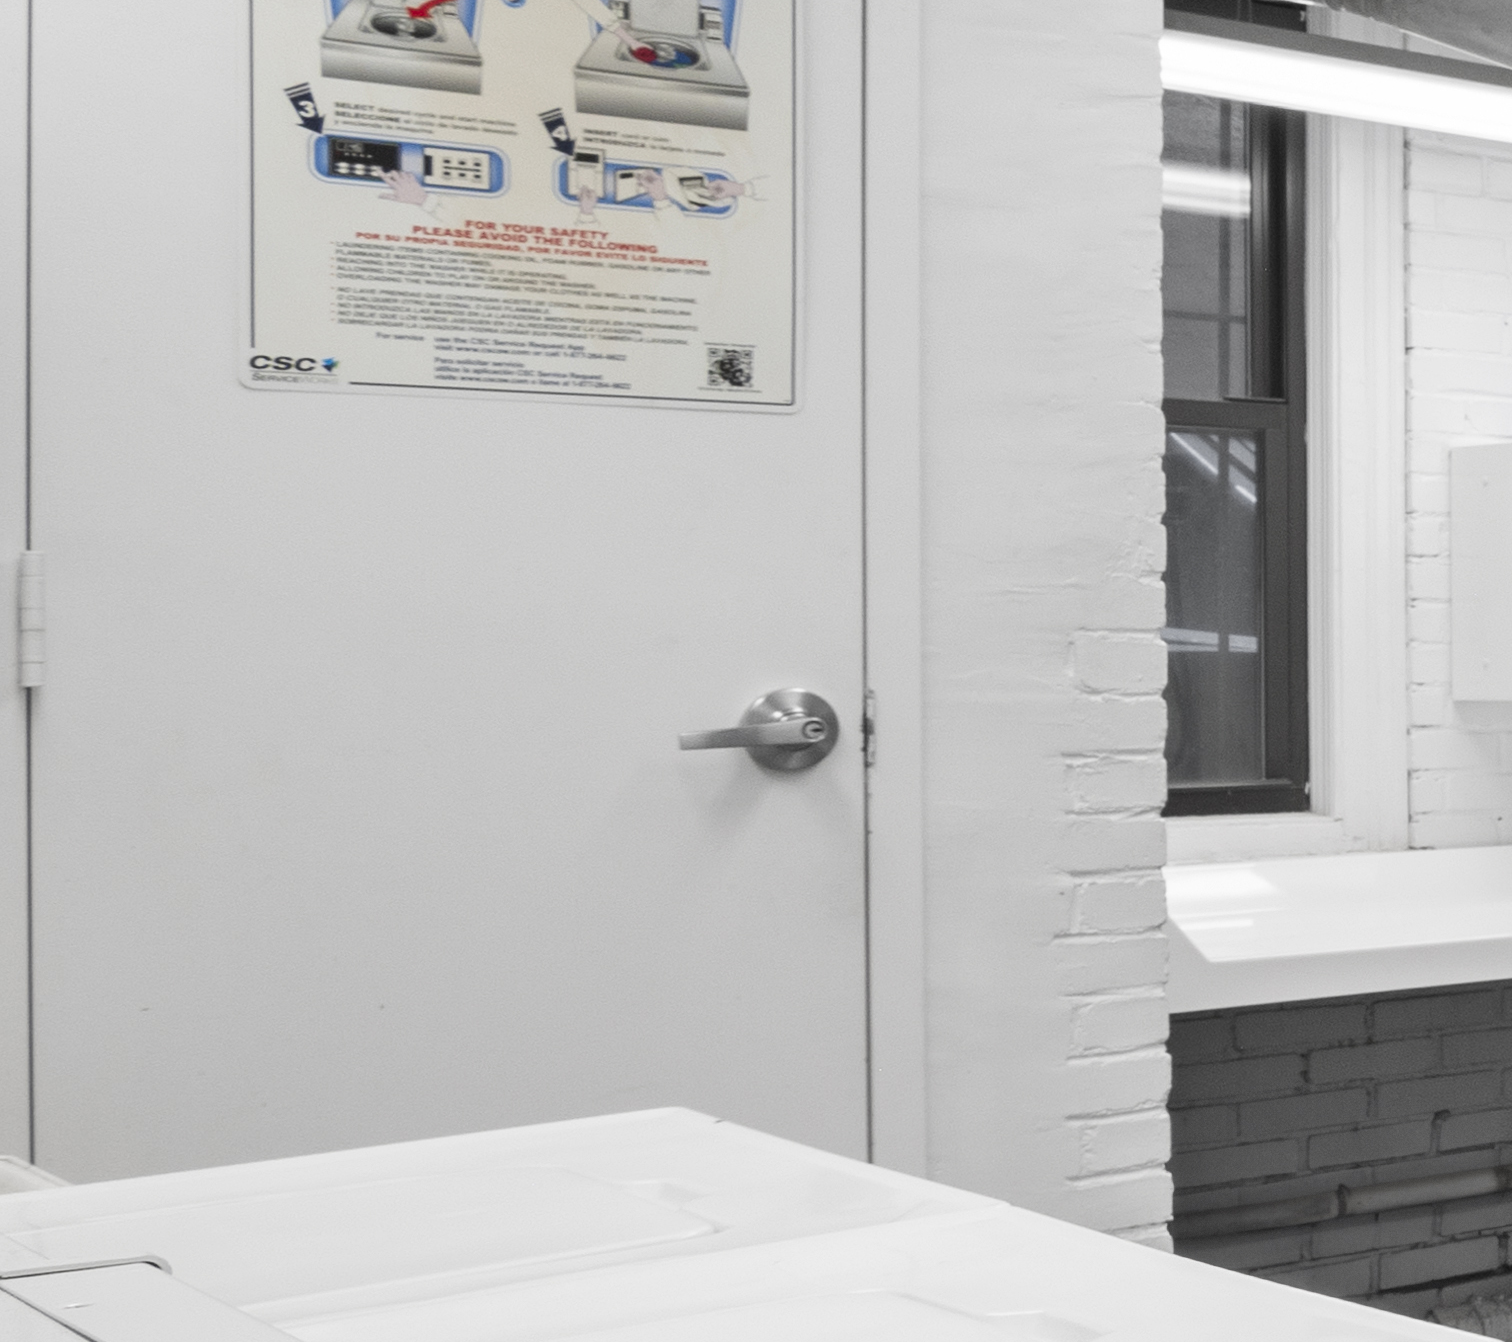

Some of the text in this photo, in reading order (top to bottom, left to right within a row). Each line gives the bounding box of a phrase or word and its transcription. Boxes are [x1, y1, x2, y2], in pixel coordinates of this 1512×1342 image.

[299, 101, 315, 117] 3
[465, 220, 608, 240] FOR YOUR SAFETY
[413, 225, 658, 254] PLEASE AVOID THE FOLLOWING
[250, 355, 317, 371] CSC
